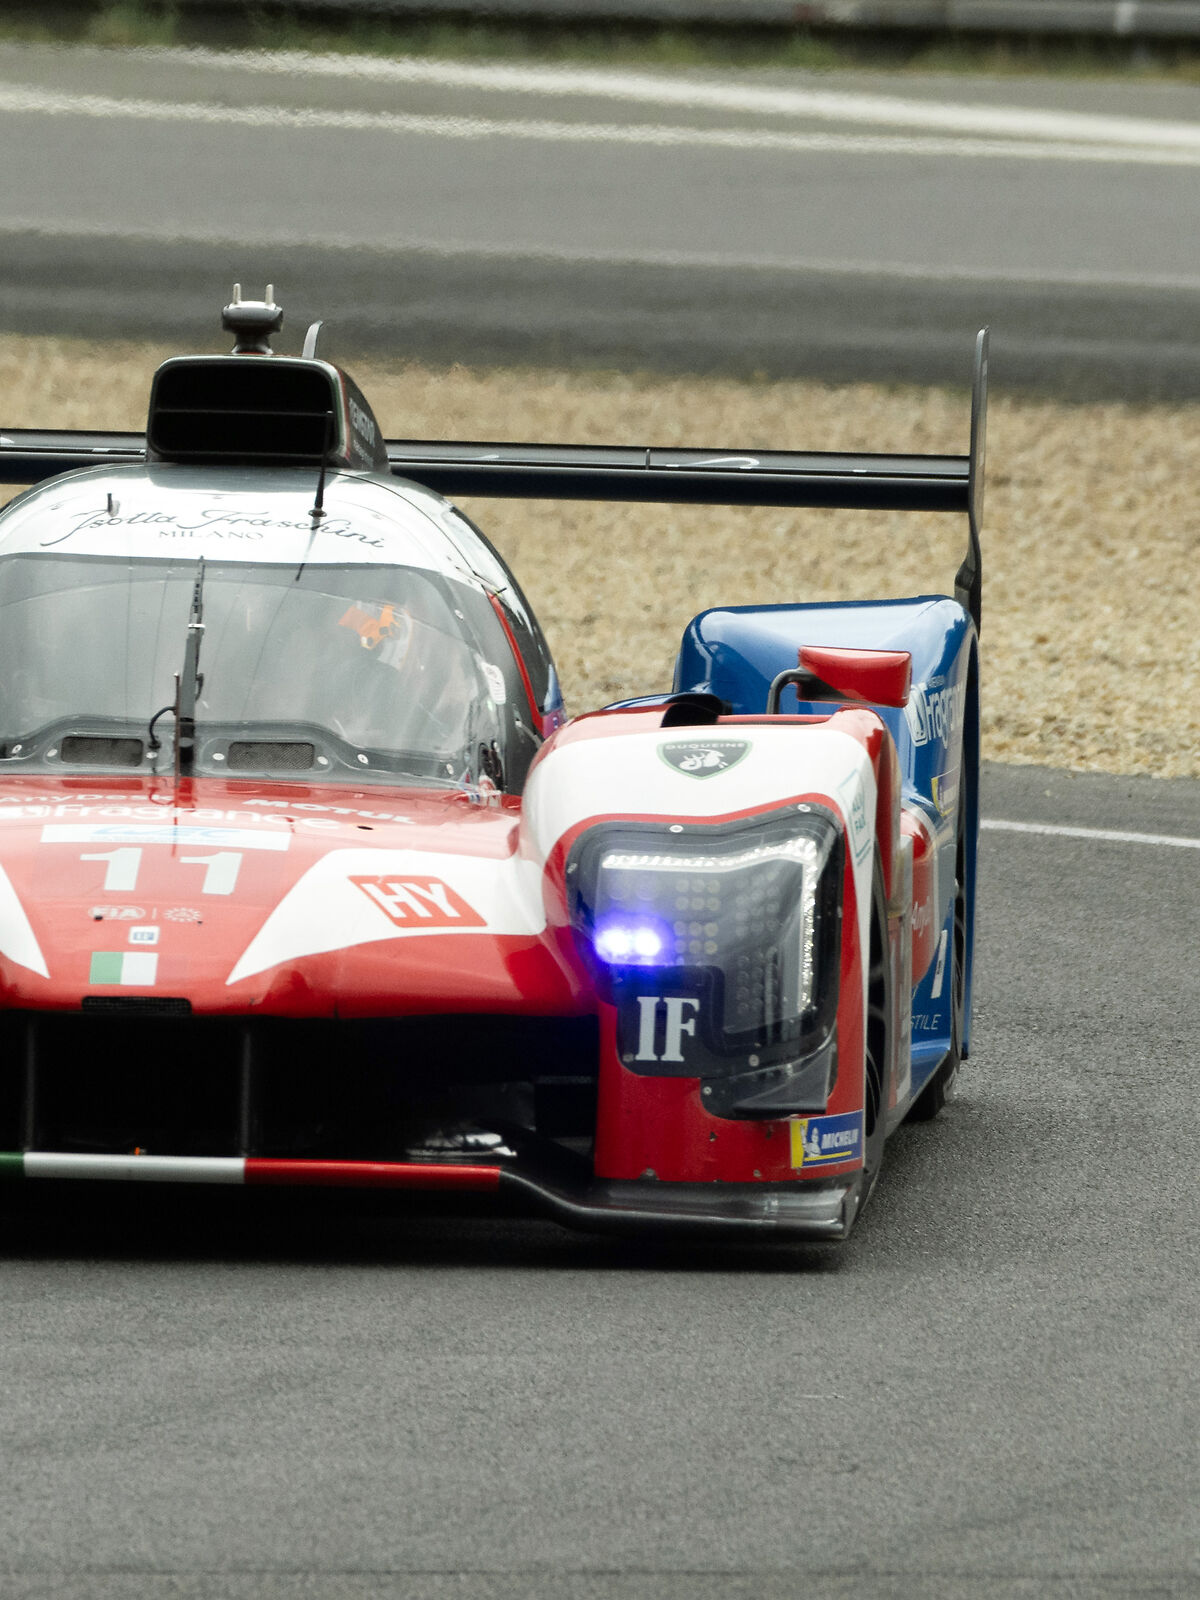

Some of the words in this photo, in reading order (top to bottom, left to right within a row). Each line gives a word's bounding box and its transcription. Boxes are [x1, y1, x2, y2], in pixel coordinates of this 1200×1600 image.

[39, 509, 178, 547] Isotta
[176, 509, 385, 549] Fraschini
[158, 530, 264, 541] MILANO
[54, 804, 341, 829] Fragrance
[243, 798, 416, 825] MOTUL
[80, 847, 243, 896] 11
[360, 883, 462, 918] HY
[634, 996, 700, 1062] IF
